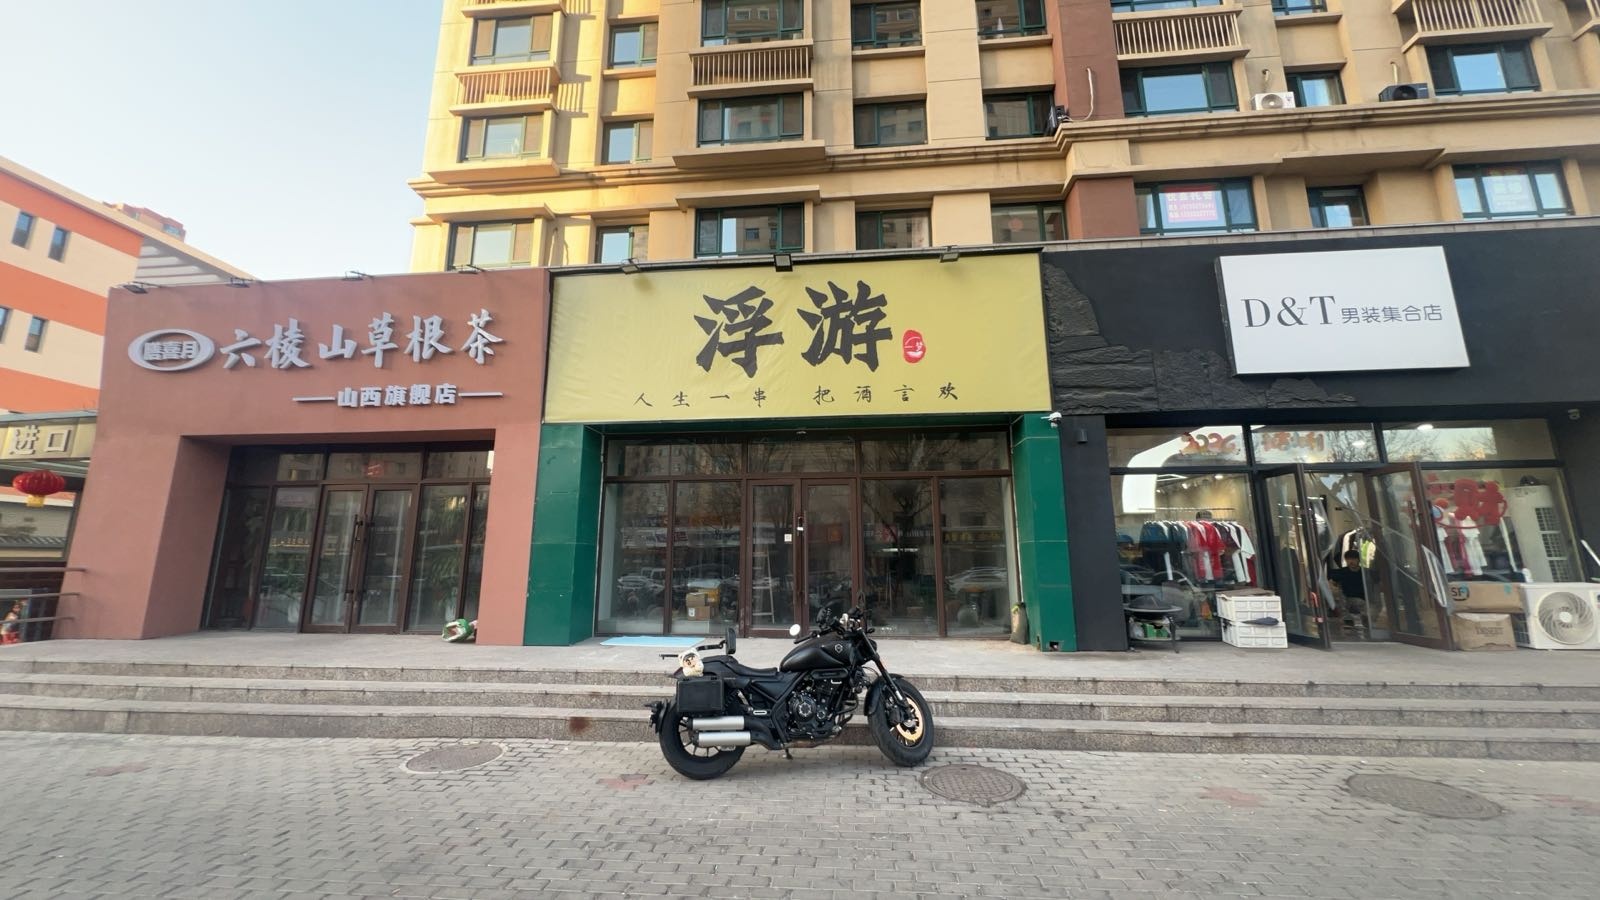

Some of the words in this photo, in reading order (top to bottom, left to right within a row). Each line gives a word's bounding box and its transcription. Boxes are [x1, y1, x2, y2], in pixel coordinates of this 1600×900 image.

[1241, 295, 1336, 328] D&T
[1341, 304, 1443, 324] 男装集合店
[219, 308, 505, 369] 六棱山草根茶
[694, 280, 893, 378] 浮游
[337, 382, 458, 408] 山西旗舰店
[633, 387, 768, 408] 人生一串
[813, 381, 958, 404] 把酒言欢
[9, 424, 74, 456] 进口
